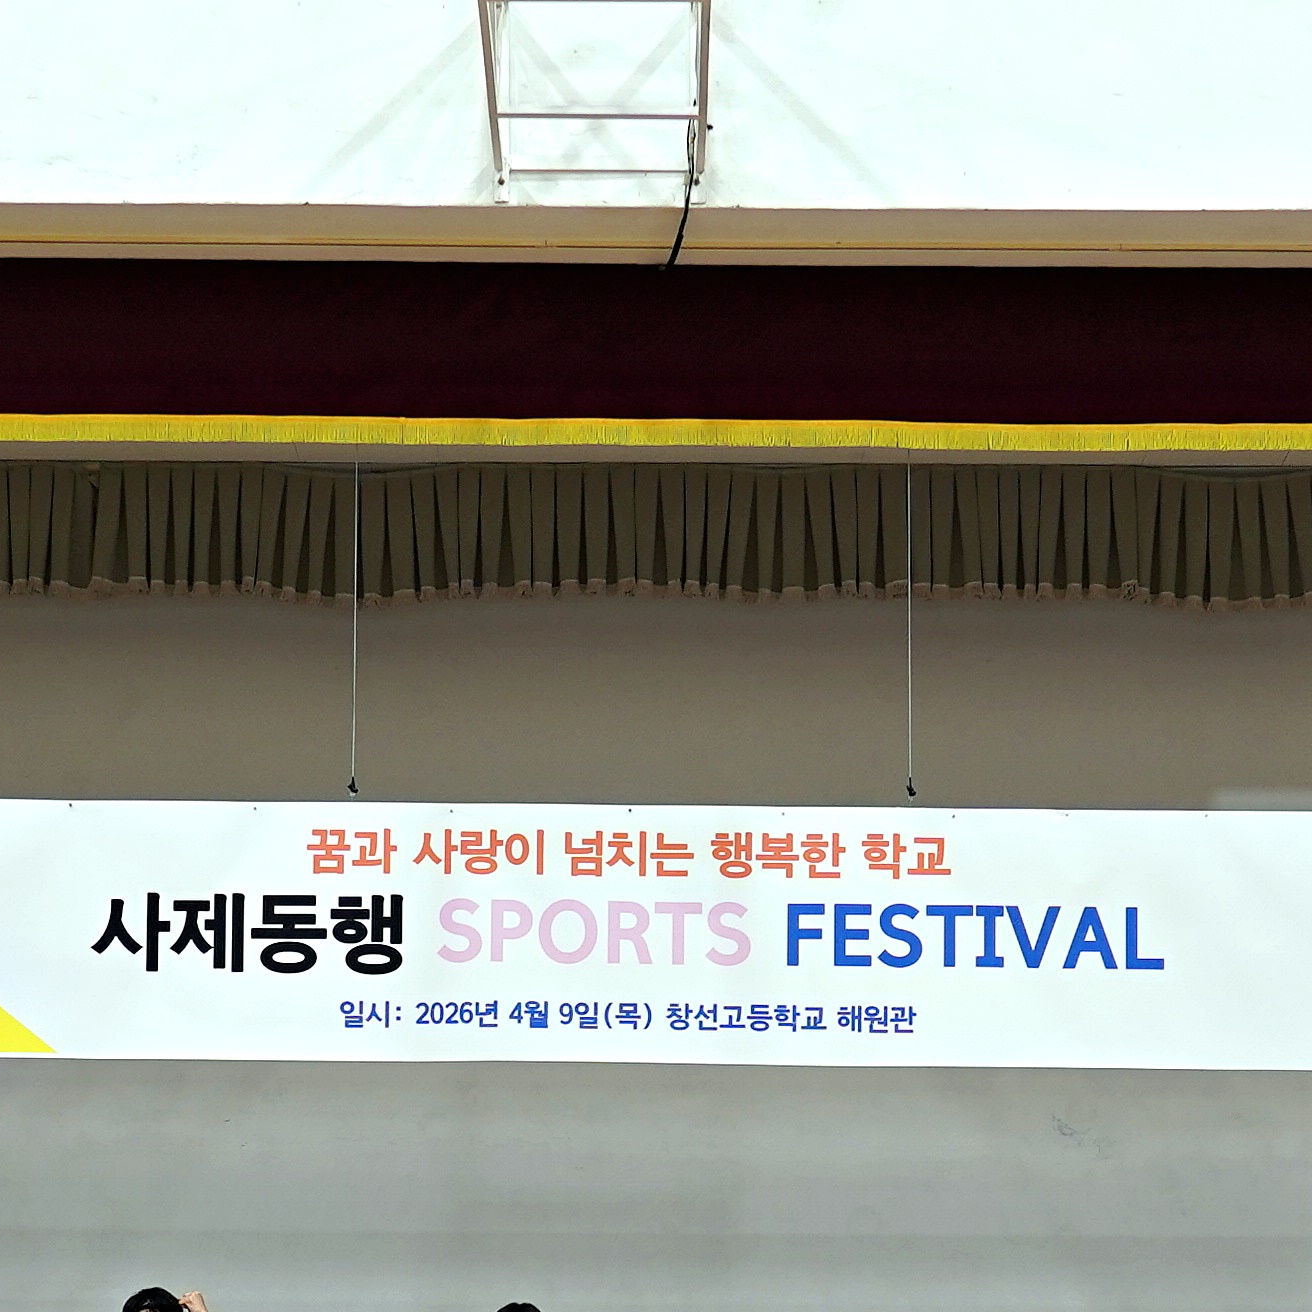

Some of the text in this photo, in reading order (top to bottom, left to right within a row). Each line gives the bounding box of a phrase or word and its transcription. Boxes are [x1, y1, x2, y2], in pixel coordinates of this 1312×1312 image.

[307, 828, 951, 879] 꿈과 사랑이 넘치는 행복한 학교
[90, 892, 1164, 975] 사제동행 SPORTS FESTIVAL
[340, 1000, 917, 1033] 일시: 2026년 4월 9일(목) 창선고등학교 해원관
